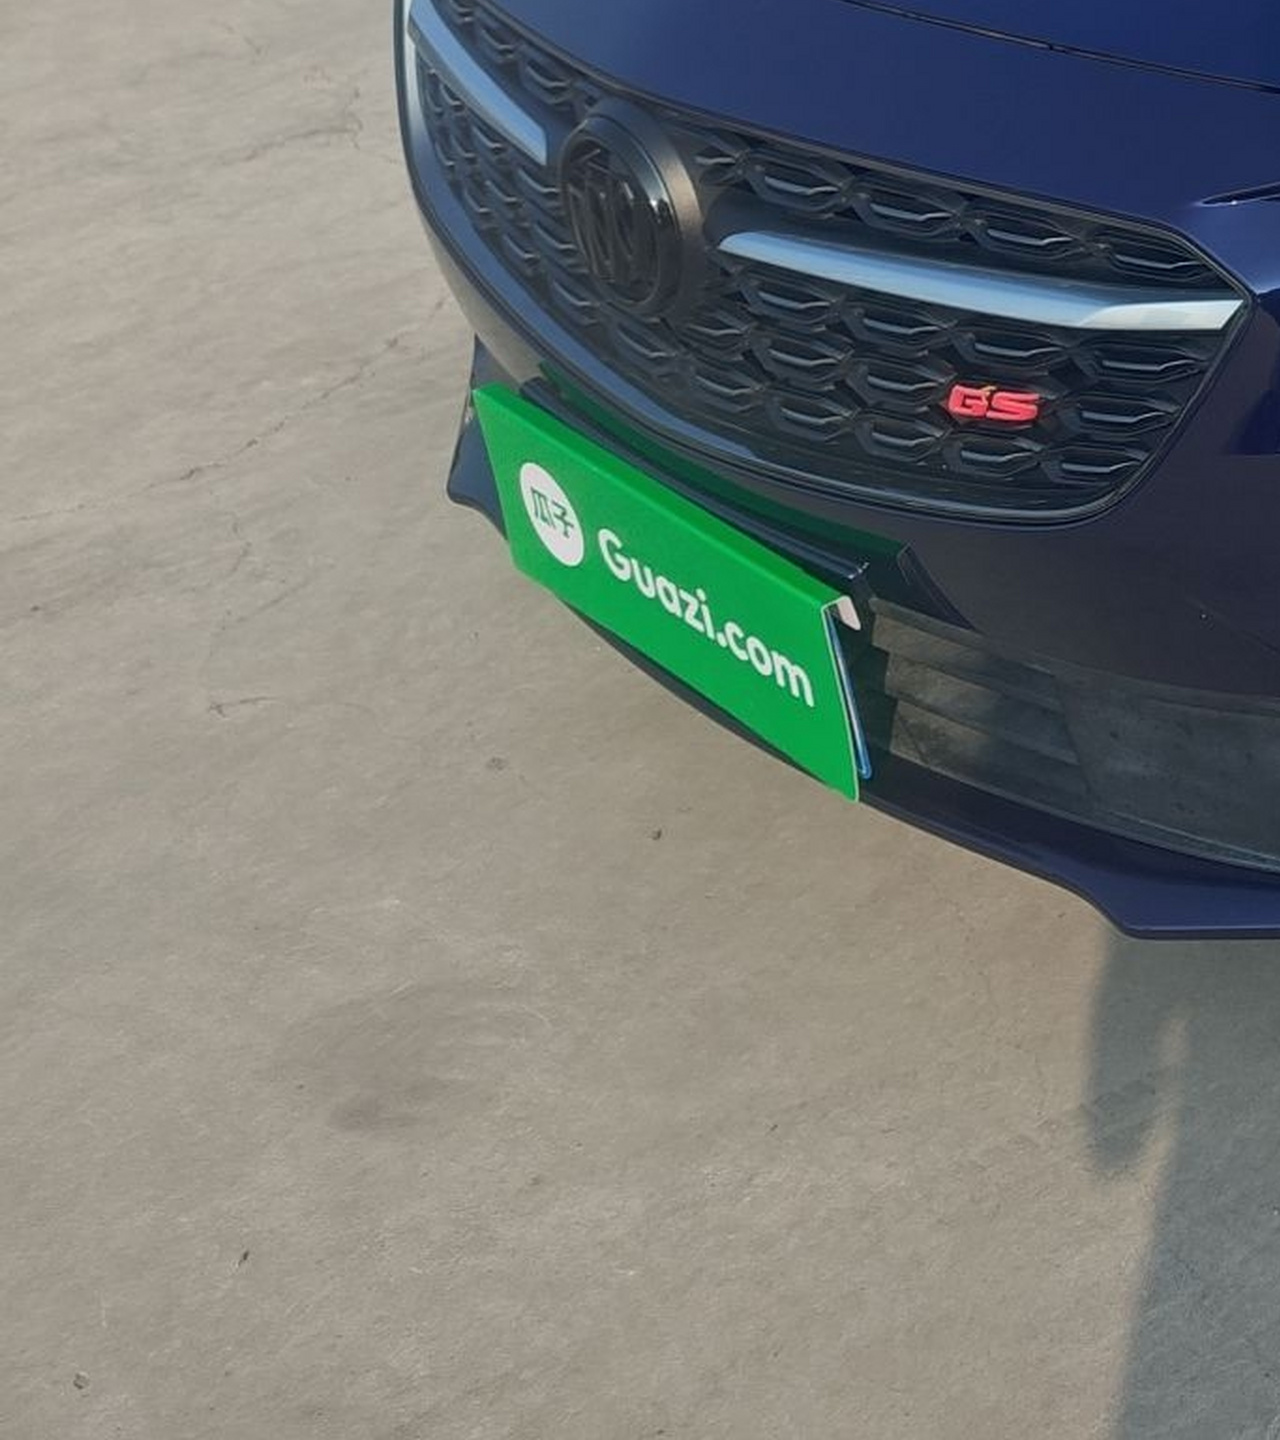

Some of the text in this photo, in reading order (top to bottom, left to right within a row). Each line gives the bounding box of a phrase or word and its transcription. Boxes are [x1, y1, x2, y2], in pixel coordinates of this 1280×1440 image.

[948, 384, 1040, 421] GS
[530, 486, 815, 707] 瓜子 Guazi.com
